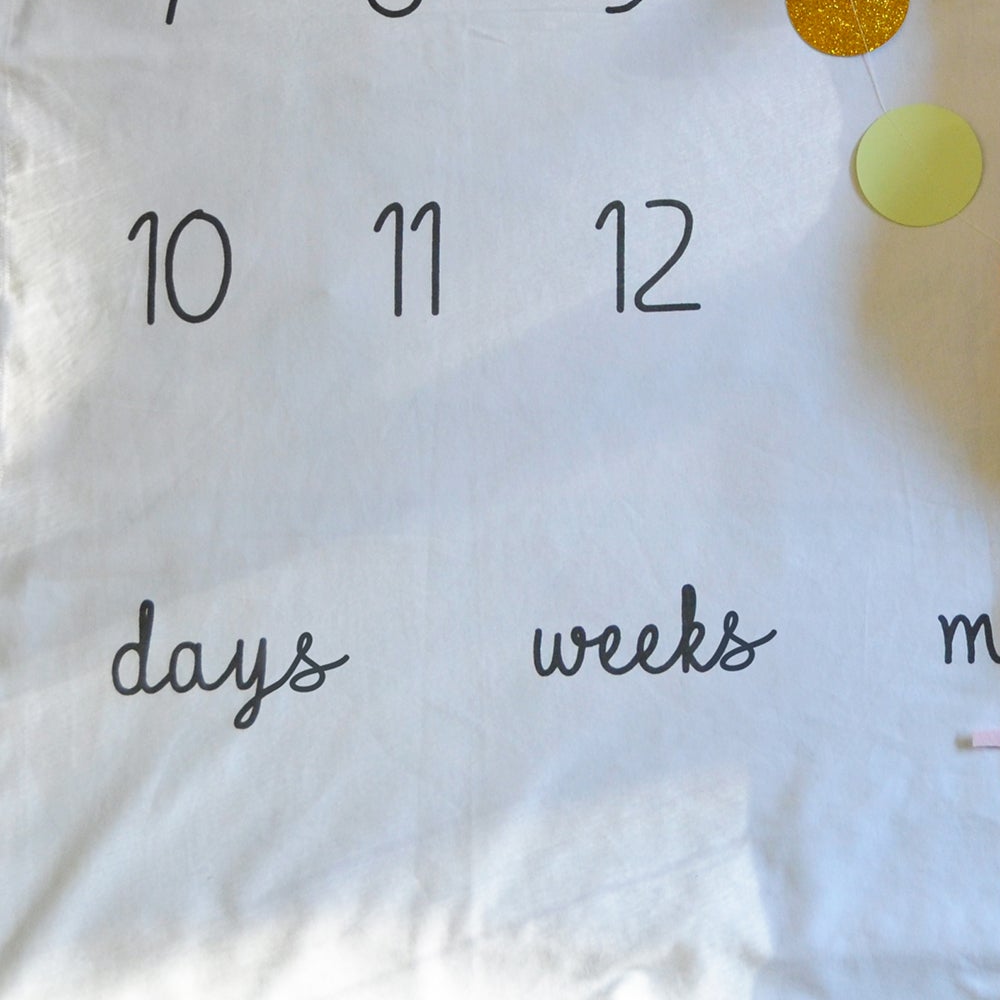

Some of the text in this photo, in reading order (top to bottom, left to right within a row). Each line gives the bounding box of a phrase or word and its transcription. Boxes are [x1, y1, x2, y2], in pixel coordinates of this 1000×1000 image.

[127, 199, 701, 326] 10 11 12
[111, 599, 350, 730] days
[533, 583, 778, 677] weeks
